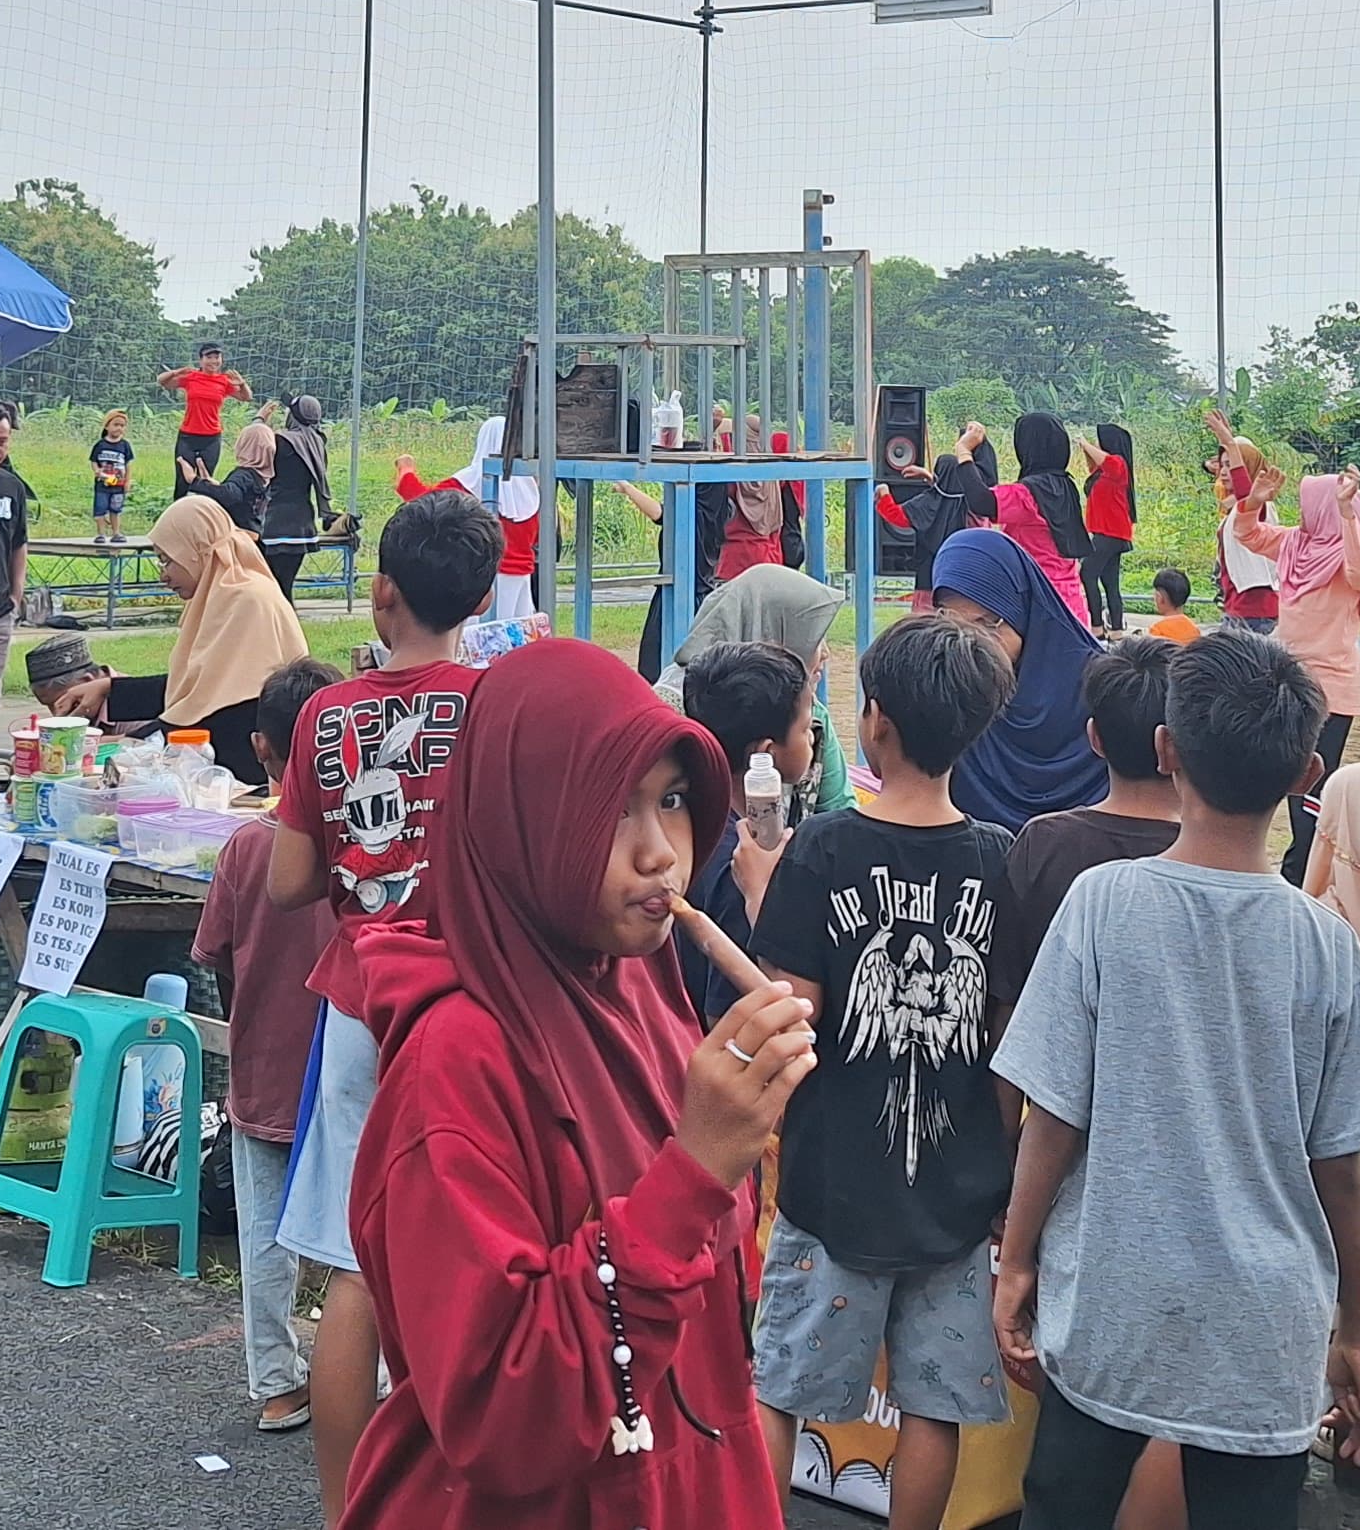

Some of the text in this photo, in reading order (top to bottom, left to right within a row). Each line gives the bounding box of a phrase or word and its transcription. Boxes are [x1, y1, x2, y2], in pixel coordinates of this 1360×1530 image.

[55, 852, 101, 876] JUAL ES
[59, 877, 73, 891] ES
[74, 881, 93, 899] TEH
[52, 896, 94, 919] ES KOPI
[826, 887, 870, 948] he
[869, 865, 938, 931] Dead
[38, 913, 54, 927] ES
[57, 916, 78, 933] POP
[33, 931, 48, 946] ES
[36, 952, 52, 967] ES
